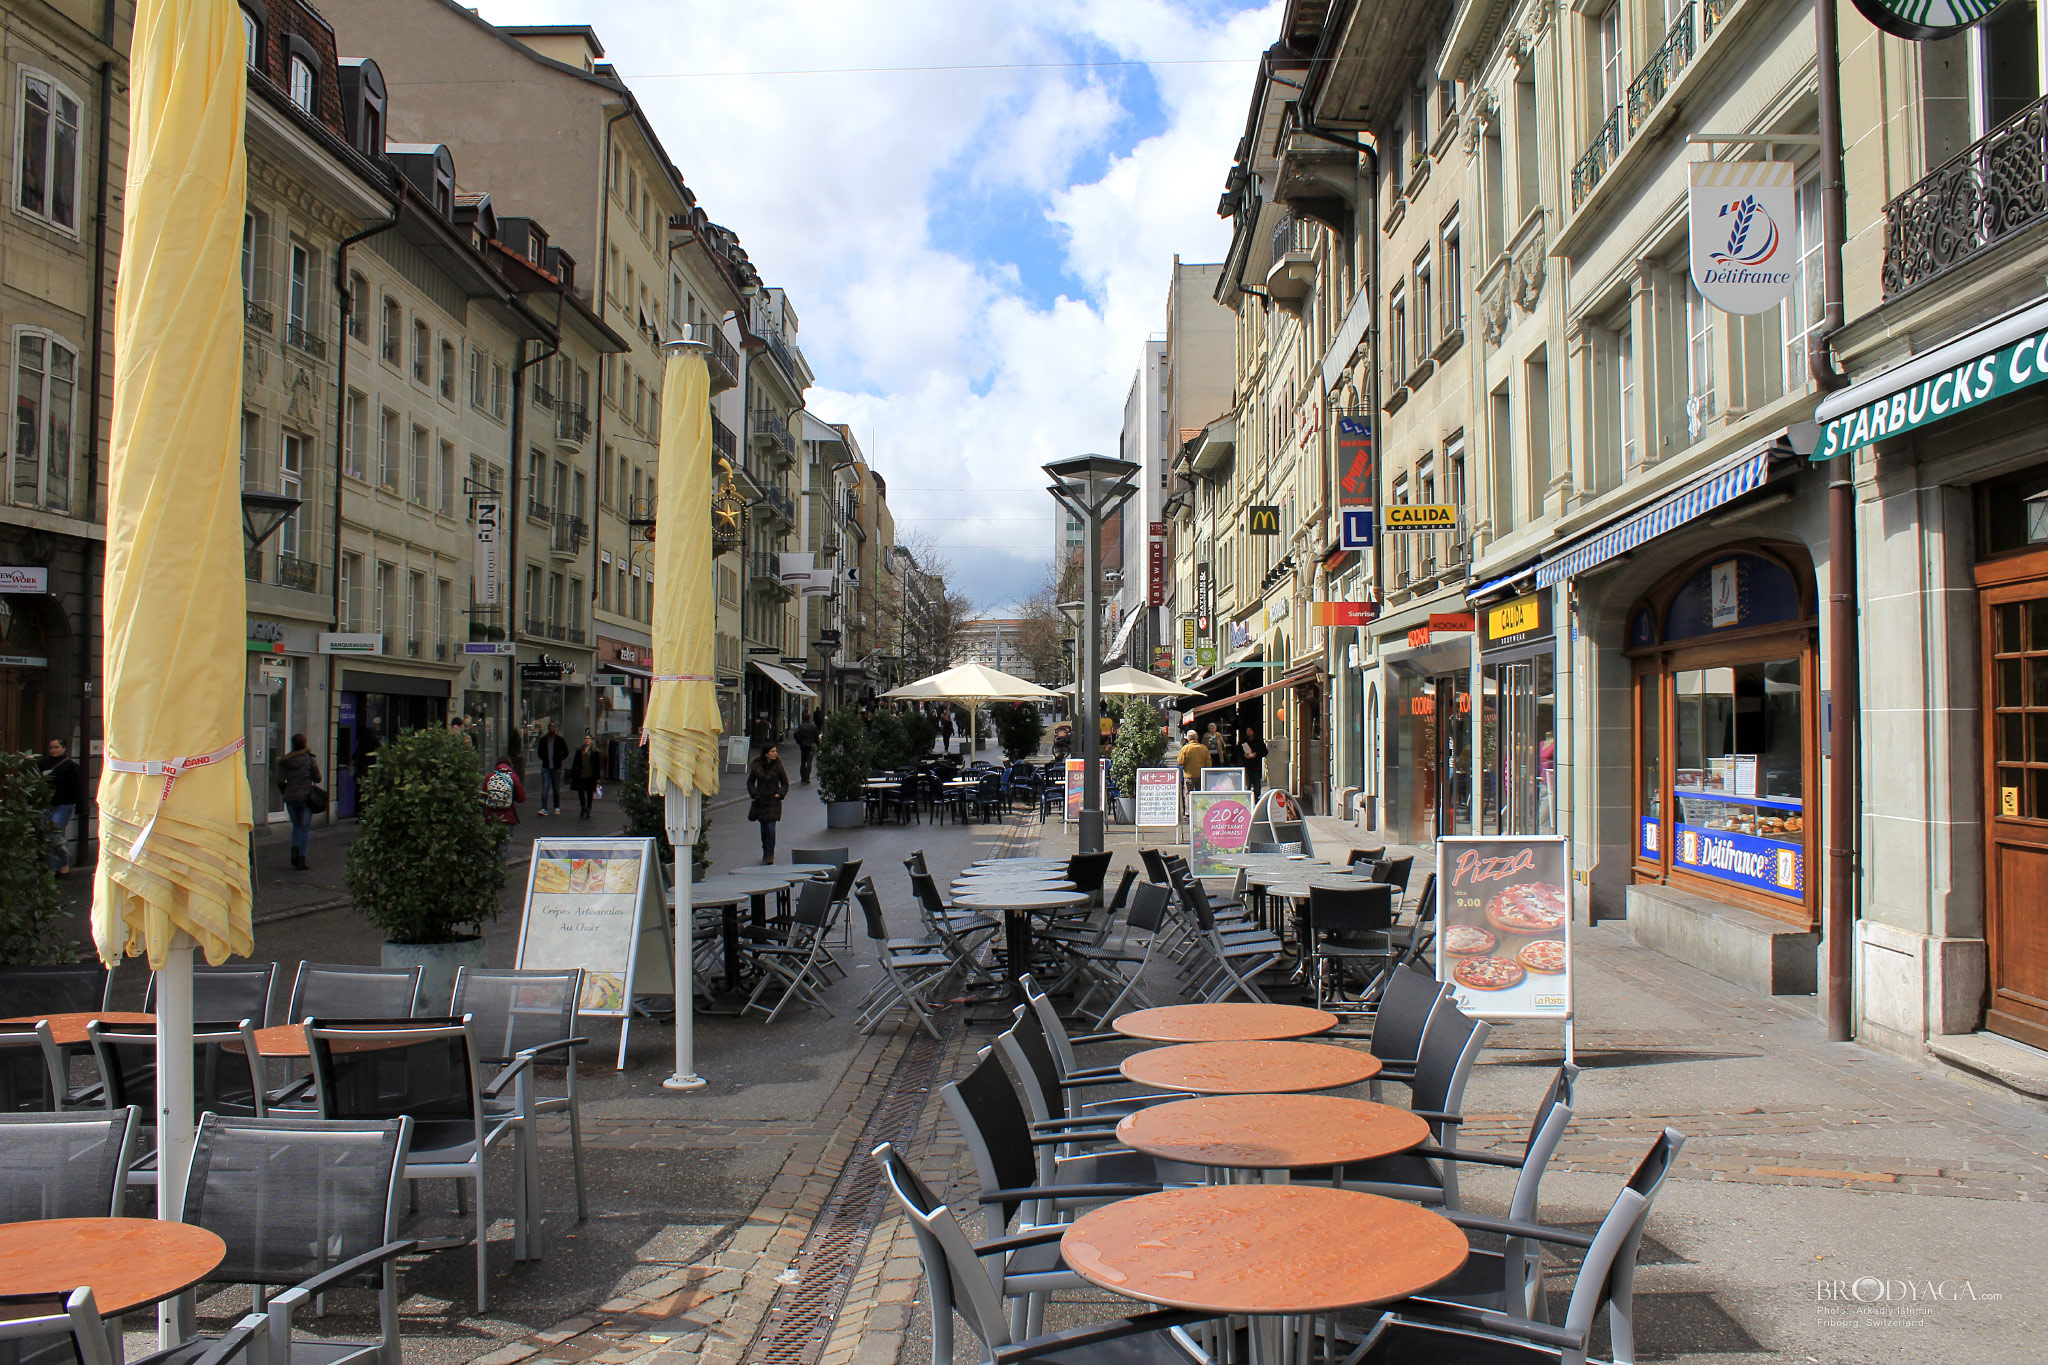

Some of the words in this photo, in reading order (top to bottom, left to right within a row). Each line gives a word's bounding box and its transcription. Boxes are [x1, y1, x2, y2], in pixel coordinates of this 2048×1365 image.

[1703, 268, 1791, 284] Délifrance
[1823, 354, 1997, 456] STARBUCKS
[1391, 509, 1450, 522] CALIDA
[1350, 516, 1367, 542] L
[12, 575, 37, 584] WORK
[486, 548, 495, 600] BOUTIQUE
[1501, 605, 1525, 631] CALIDA
[620, 646, 635, 662] zebra
[1210, 808, 1245, 823] 20%
[1702, 837, 1765, 879] Délifrance
[1452, 848, 1535, 887] Pizza
[1457, 898, 1481, 907] 9.00
[573, 906, 624, 916] Artisanales
[560, 922, 573, 931] Au
[576, 922, 600, 931] Choix
